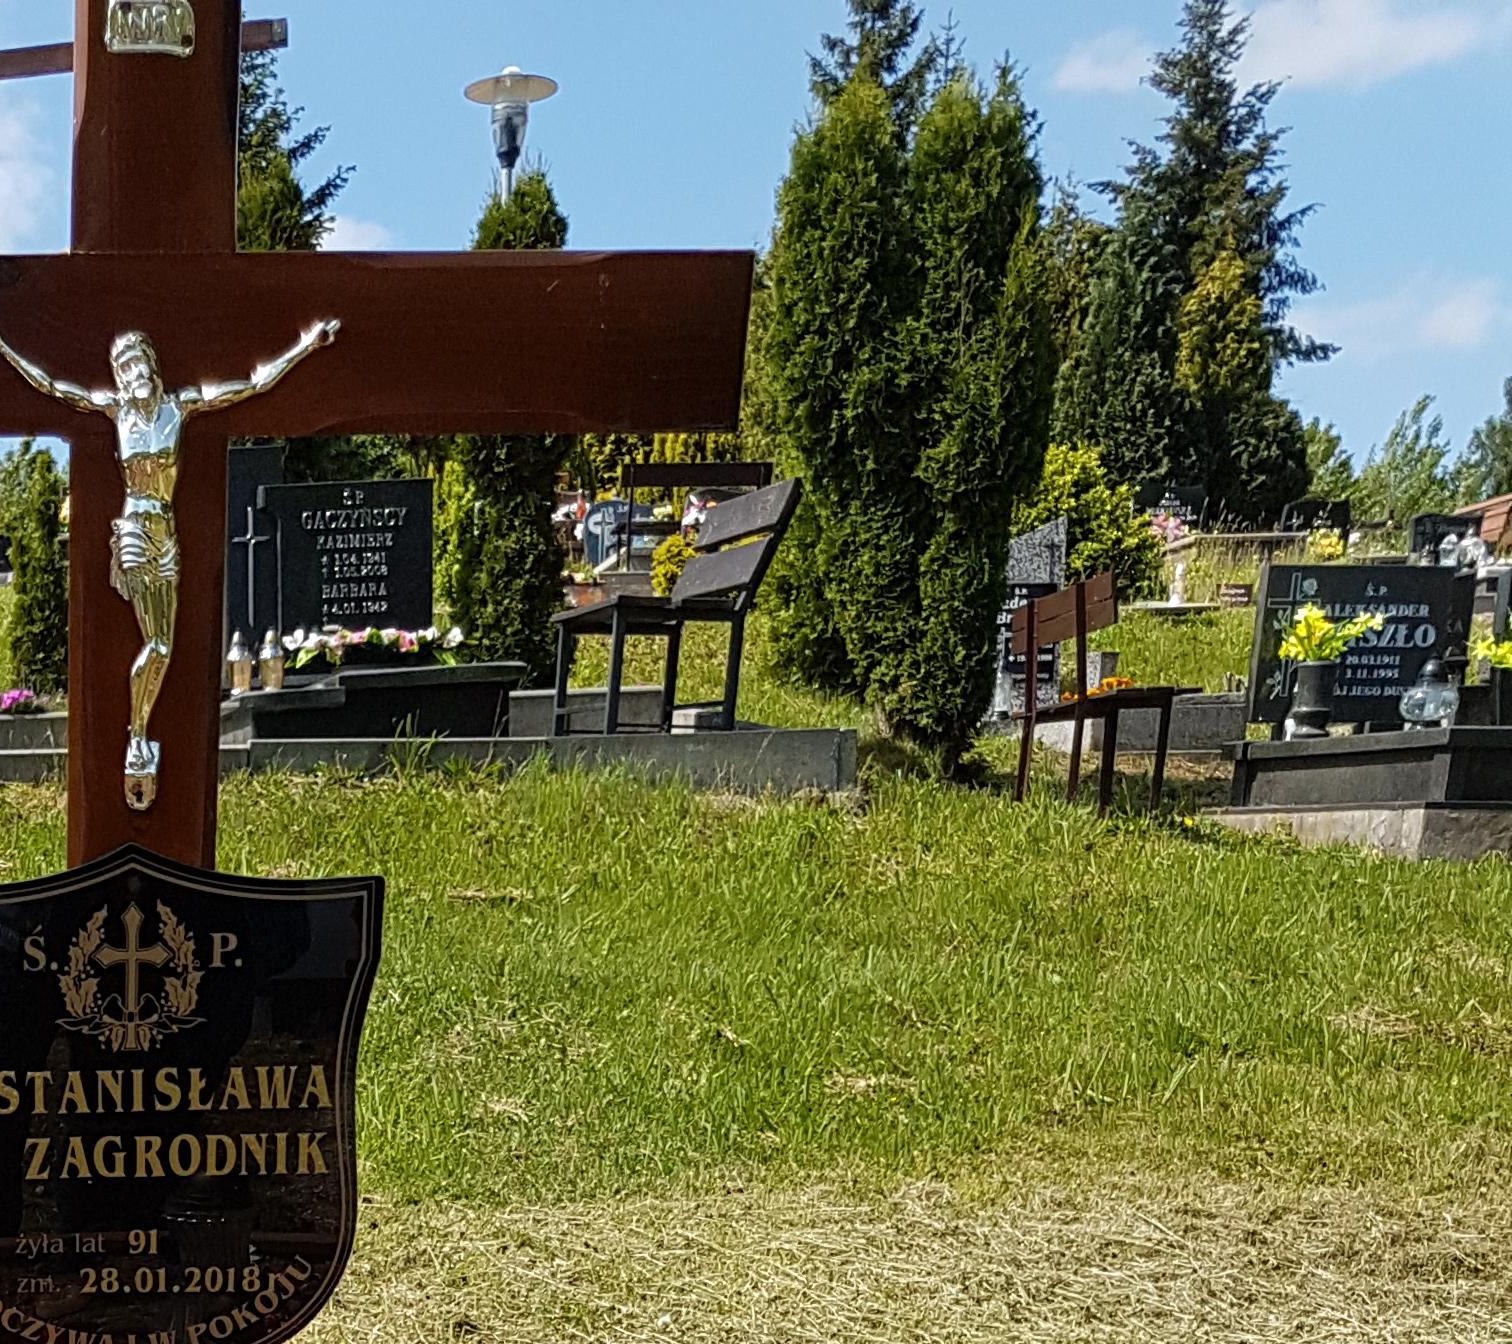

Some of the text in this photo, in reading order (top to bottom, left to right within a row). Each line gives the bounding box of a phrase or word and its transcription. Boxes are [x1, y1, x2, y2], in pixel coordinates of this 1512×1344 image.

[316, 532, 393, 550] KAZIMIERZ
[322, 582, 387, 599] BARBARA
[1325, 603, 1430, 617] ALEKSANDER
[209, 932, 243, 968] P.
[24, 1132, 329, 1180] ZAGRODNIK
[15, 1229, 158, 1259] żyła lat 91
